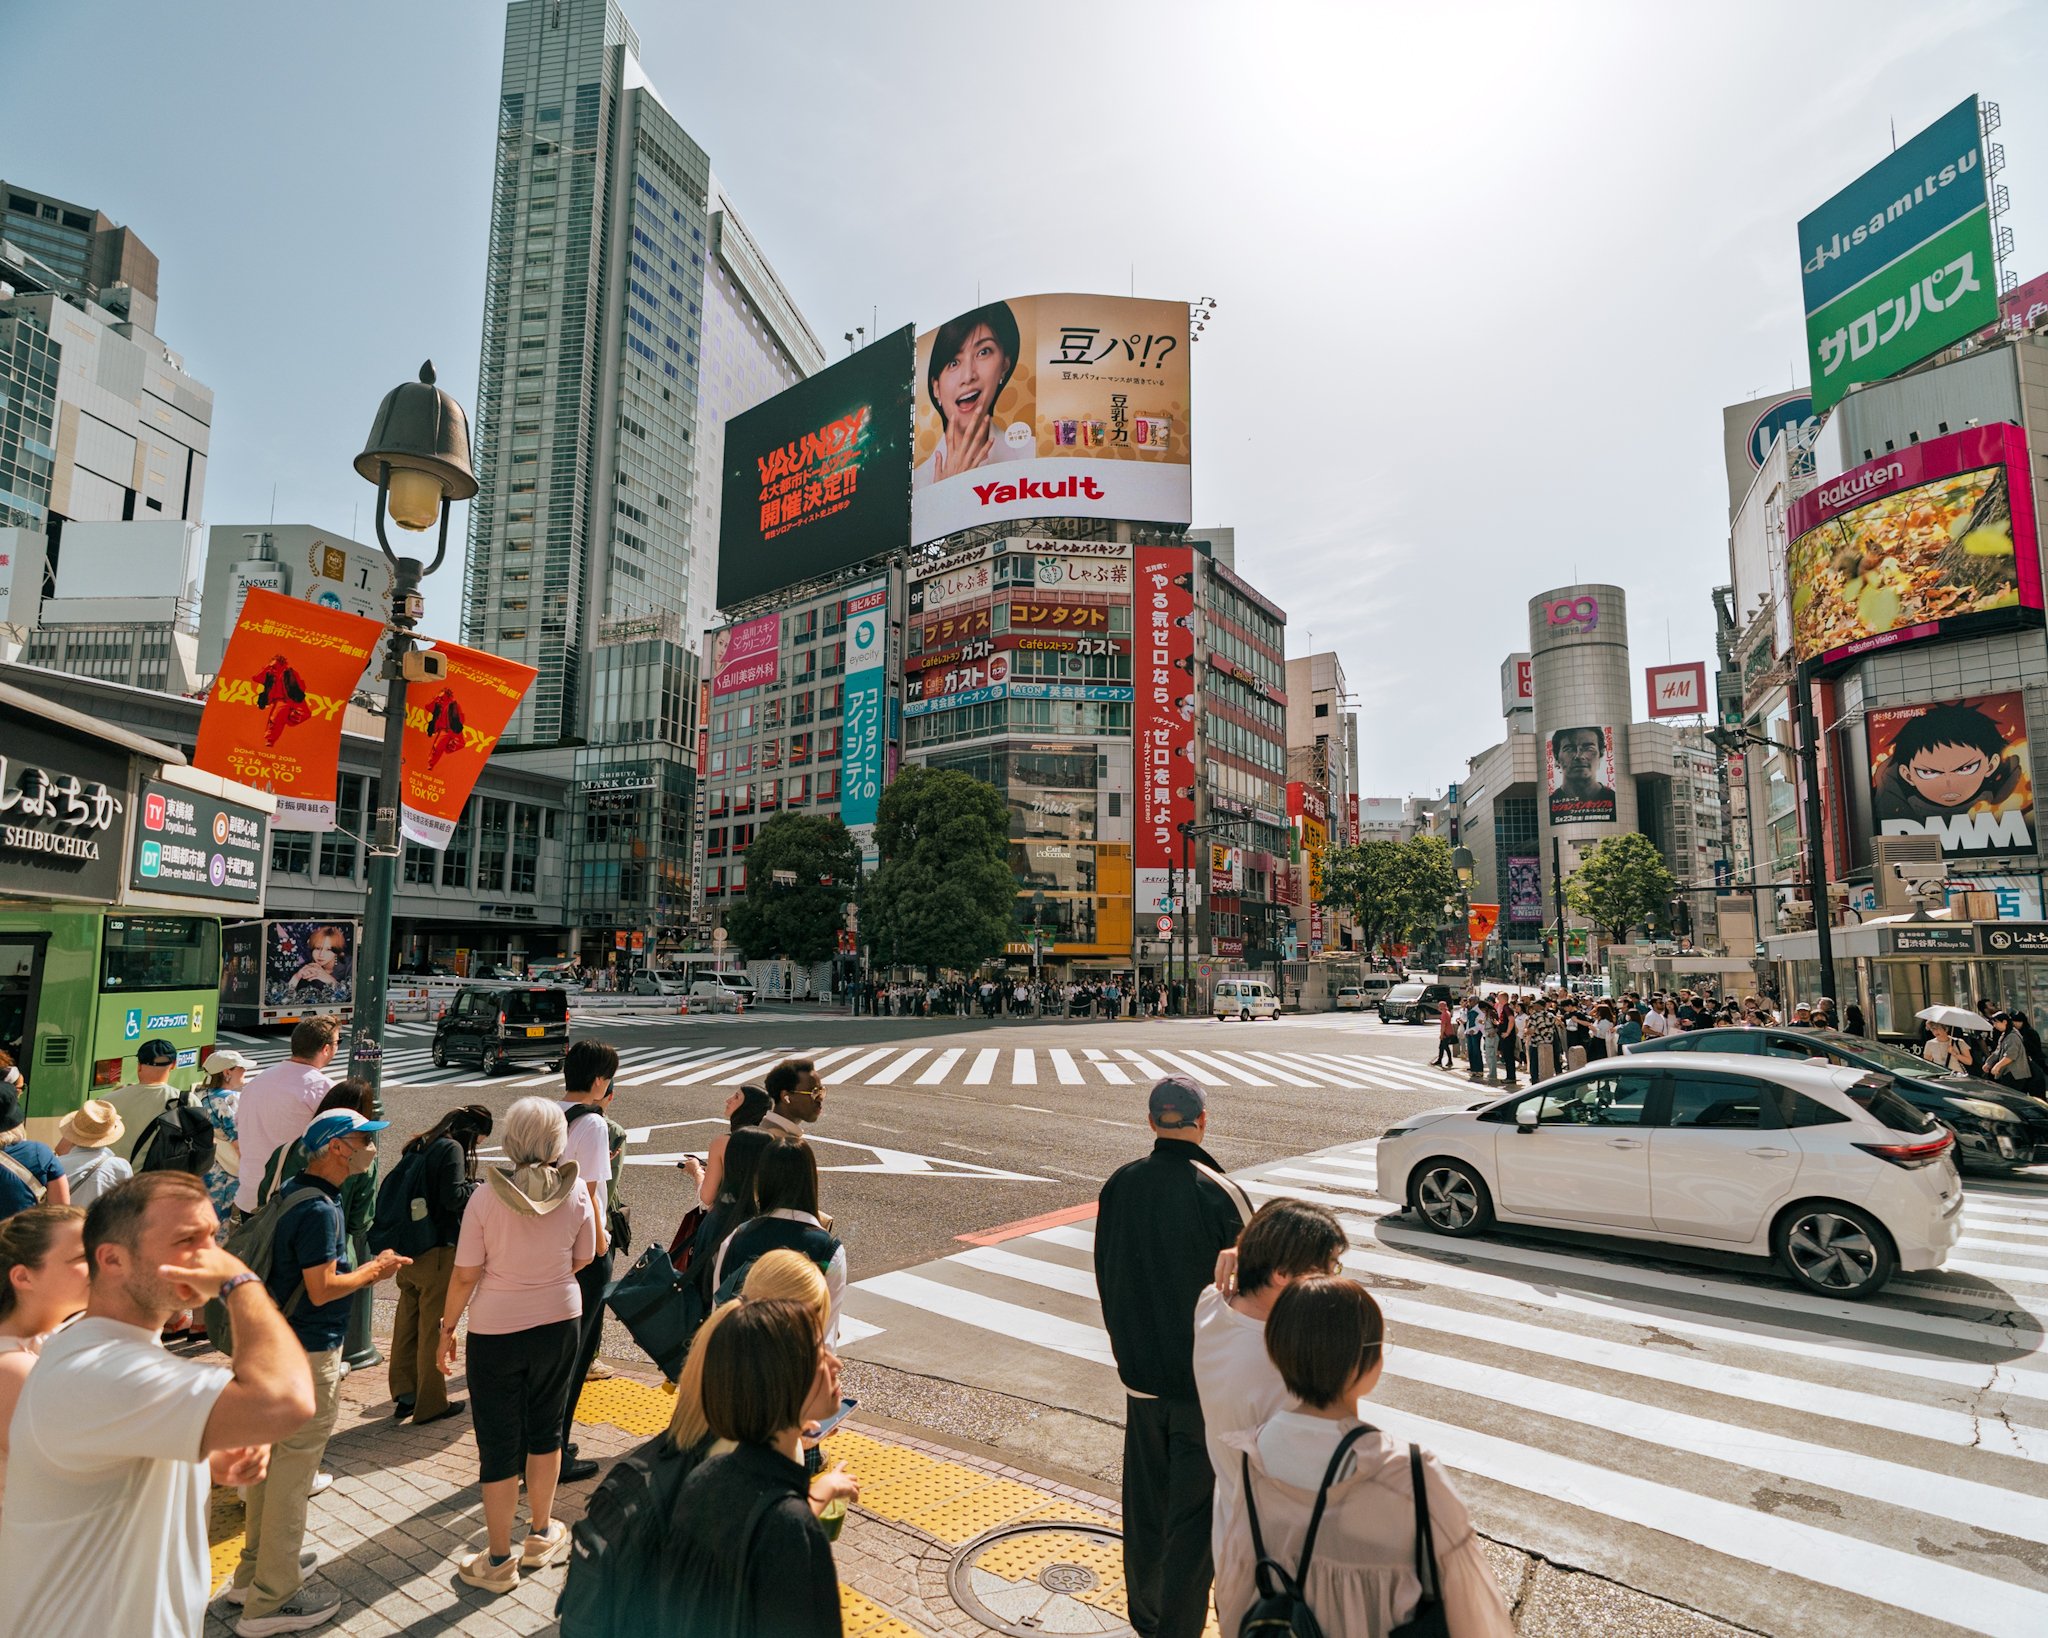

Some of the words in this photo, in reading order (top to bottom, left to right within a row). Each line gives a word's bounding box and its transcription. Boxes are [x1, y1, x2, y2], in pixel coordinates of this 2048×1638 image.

[1804, 148, 1977, 275] Hisamitsu
[1817, 251, 1981, 378] サロンパス
[1062, 371, 1165, 386] 豆乳パフォーマンスが活きている
[1111, 394, 1128, 442] 豆乳の力
[757, 404, 868, 486] VAUNDY
[972, 476, 1105, 506] Yakult
[1818, 462, 1904, 510] Rakuten
[1026, 539, 1126, 555] しゃぶしゃぶバイキング
[948, 569, 989, 594] しゃぶ葉
[1069, 563, 1127, 583] しゃぶ葉
[239, 579, 278, 588] ANSWER
[850, 593, 882, 613] 当ビル5F
[911, 592, 923, 605] 9F
[1012, 605, 1105, 625] コンタクト
[1541, 596, 1598, 634] 109
[742, 621, 775, 641] 品川スキン
[924, 611, 991, 643] プライス
[741, 634, 772, 652] クリニック
[1848, 639, 1875, 653] Rakuten
[1876, 633, 1898, 648] Vision
[722, 662, 774, 688] 品川美容外科
[944, 667, 985, 693] ガスト
[908, 682, 923, 697] 7F
[1015, 686, 1041, 695] AEON
[1049, 686, 1131, 699] 英会話イーオン
[1662, 680, 1691, 699] H&M
[931, 690, 988, 710] 英会話イーオン
[846, 691, 865, 800] アイシティ
[863, 688, 878, 798] コンタクトの
[258, 751, 276, 760] TOUR
[234, 764, 295, 783] TOKYO
[272, 762, 302, 773] 02.15
[600, 771, 637, 779] SHIBUYA
[0, 755, 123, 831] しぶちか
[411, 785, 440, 802] TOKYO
[581, 779, 620, 790] MARK
[625, 777, 657, 787] CITY
[1153, 729, 1171, 854] ゼロを見よう。
[149, 804, 162, 820] TY
[166, 798, 194, 821] 東横線
[165, 819, 184, 835] Toyoko
[185, 823, 197, 836] Line
[5, 826, 100, 860] SHIBUCHIKA
[251, 840, 260, 851] Line
[144, 851, 158, 867] DT
[161, 844, 206, 868] 田園都市線
[160, 864, 195, 881] Den-en-toshi
[196, 870, 207, 883] Line
[226, 856, 255, 877] 半蔵門線
[248, 879, 258, 890] Line
[1909, 939, 1937, 948] 渋谷駅
[147, 1015, 188, 1028] ノンステップバス
